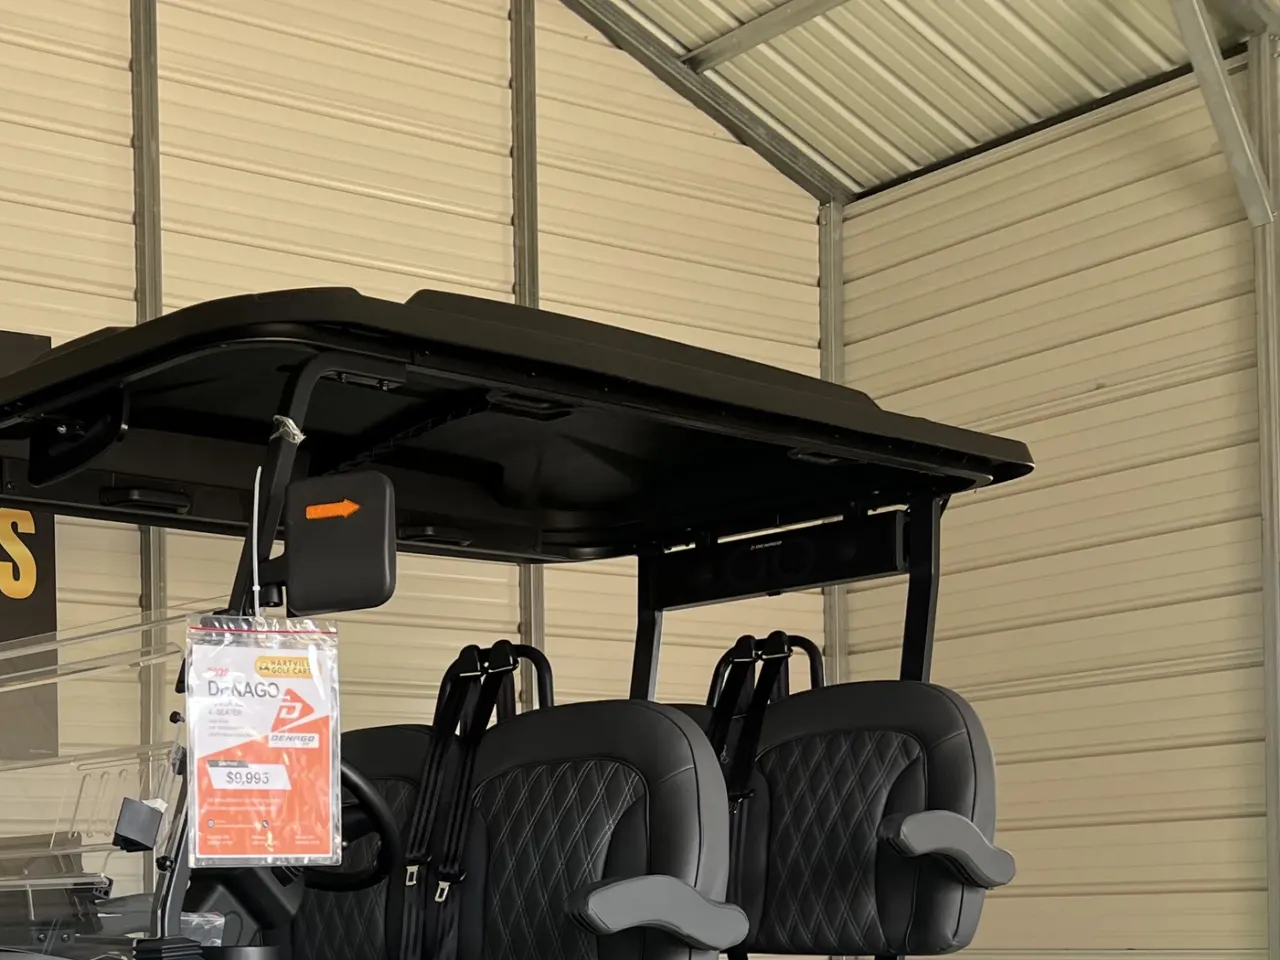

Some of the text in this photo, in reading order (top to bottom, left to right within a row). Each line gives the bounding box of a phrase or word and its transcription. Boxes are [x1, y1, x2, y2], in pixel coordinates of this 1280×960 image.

[270, 659, 311, 668] HARTVILL
[292, 667, 312, 675] CART
[271, 734, 316, 742] DENAGO
[226, 770, 270, 786] $9,995
